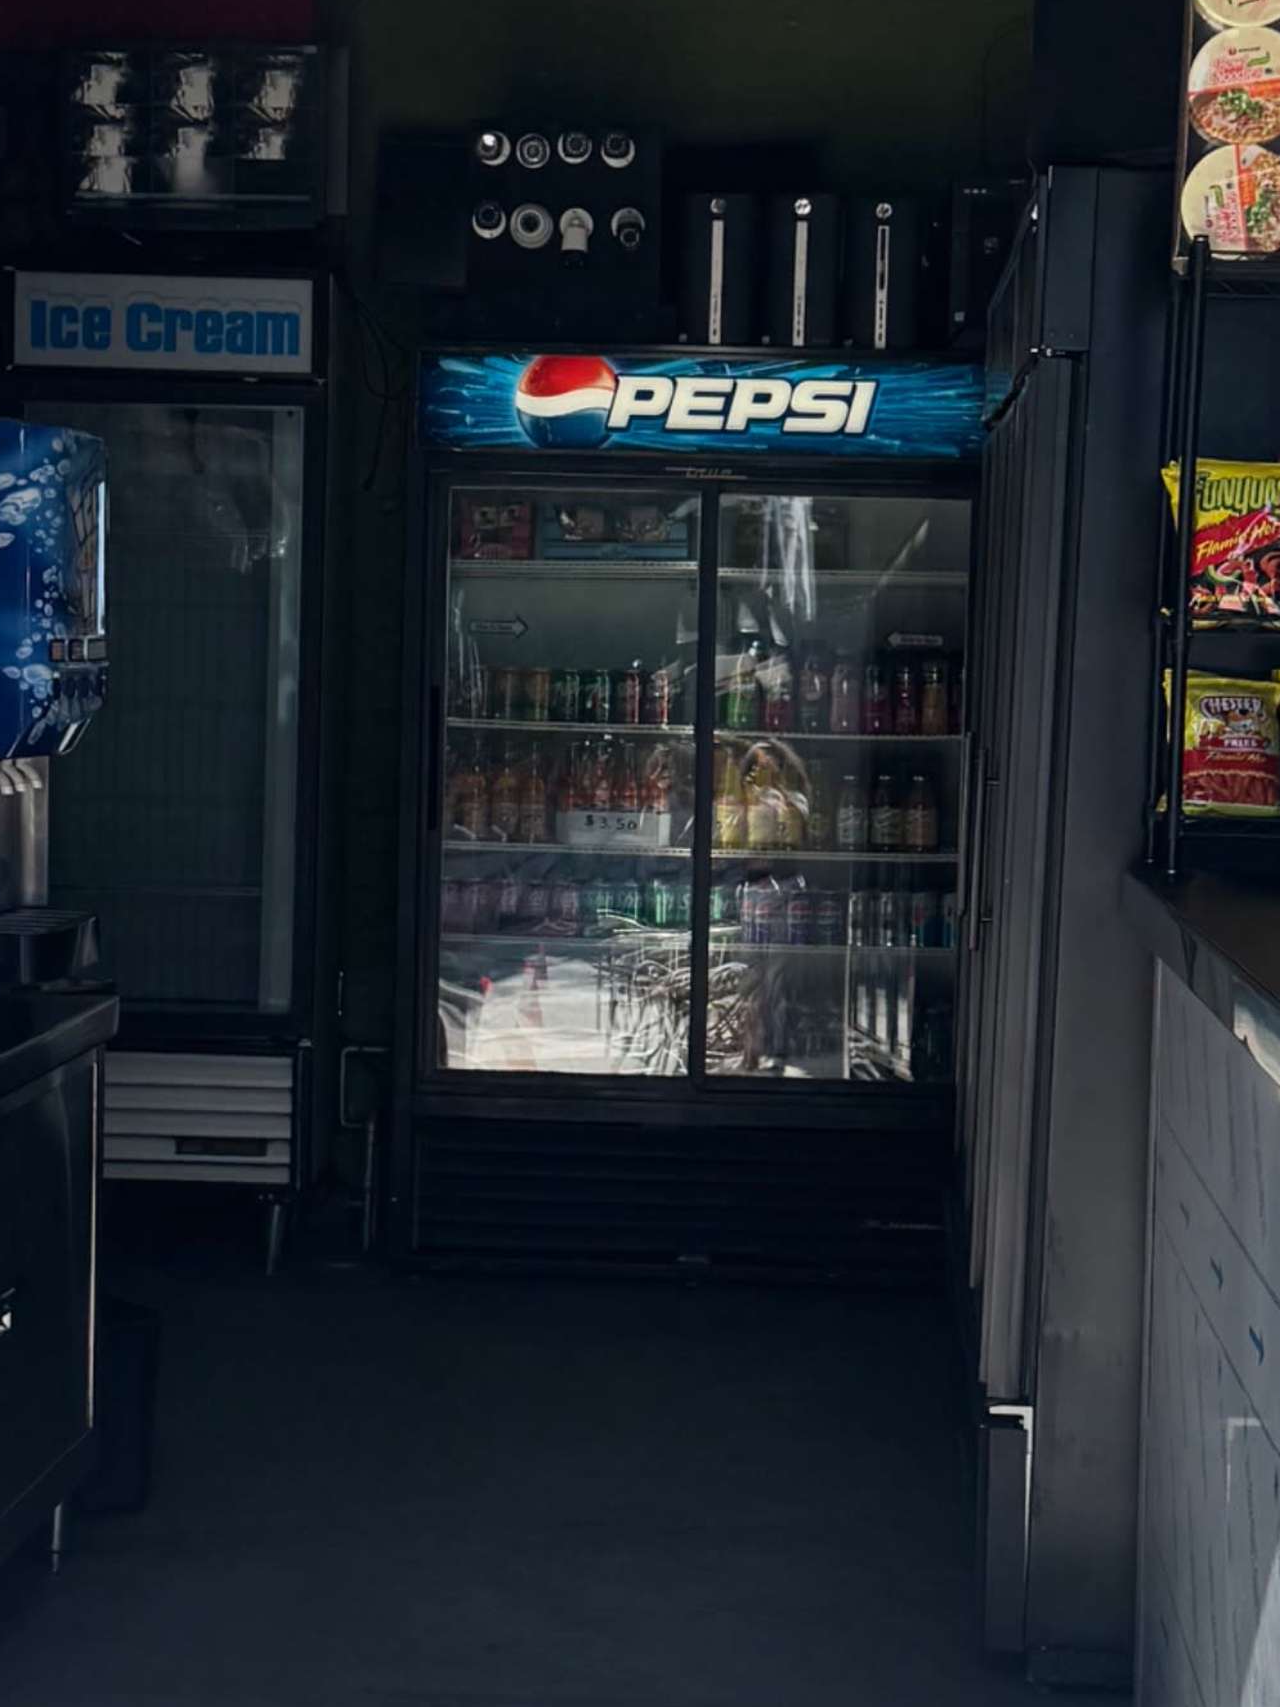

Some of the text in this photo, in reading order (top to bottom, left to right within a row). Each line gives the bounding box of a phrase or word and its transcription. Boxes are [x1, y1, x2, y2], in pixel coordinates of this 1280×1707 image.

[30, 299, 300, 357] Ice Cream
[606, 374, 878, 435] PEPSI
